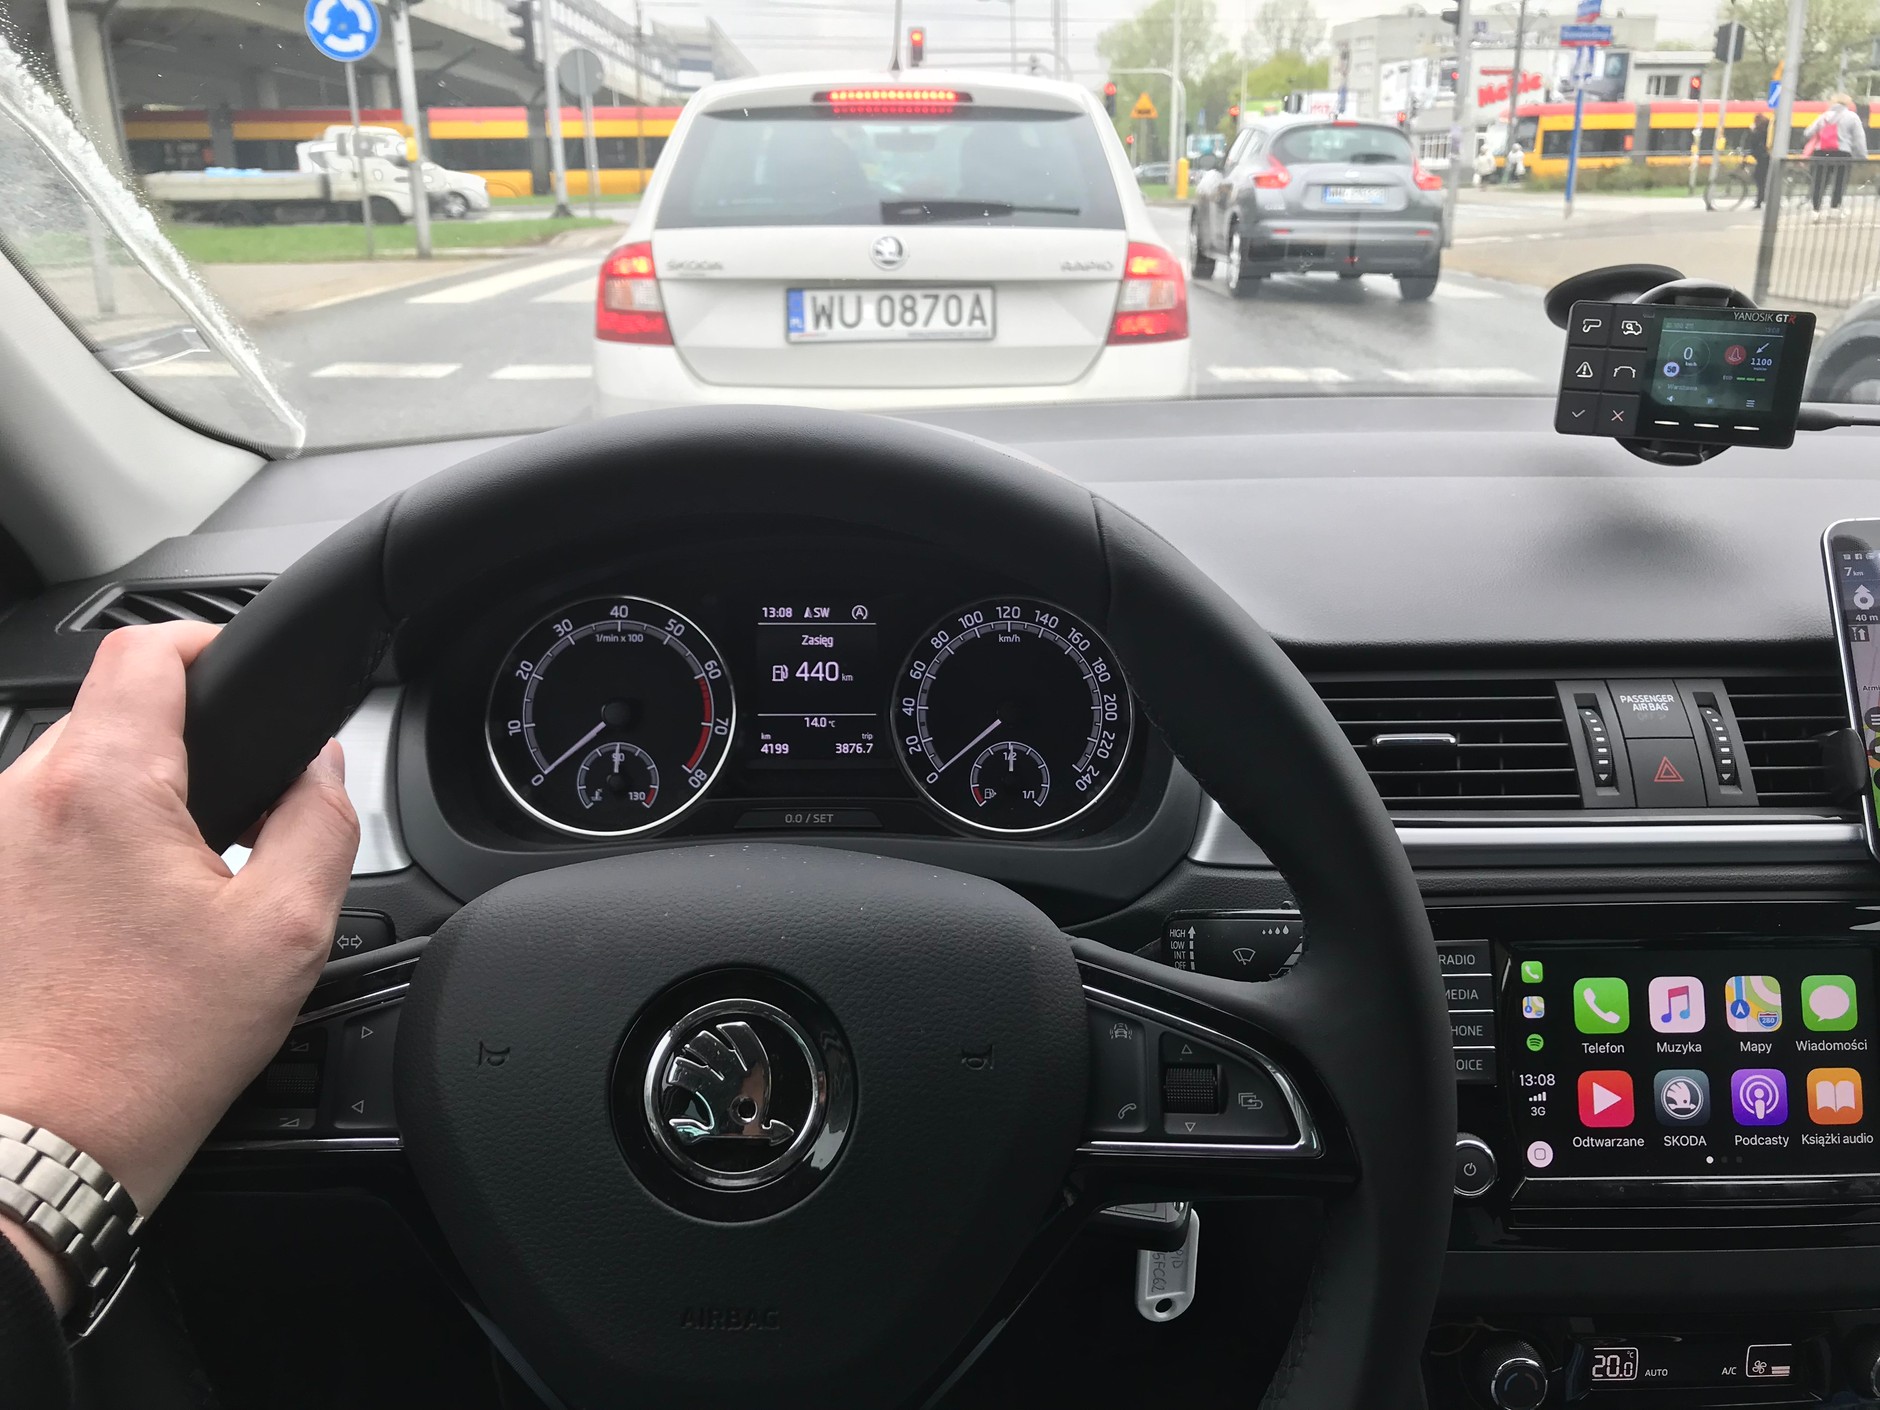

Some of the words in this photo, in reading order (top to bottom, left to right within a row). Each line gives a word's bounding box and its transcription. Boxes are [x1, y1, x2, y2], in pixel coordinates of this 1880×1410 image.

[810, 295, 863, 330] WU
[875, 293, 988, 328] 0870A
[1733, 311, 1774, 322] YANOSIK
[1775, 313, 1797, 324] GTR
[1683, 346, 1694, 360] 0
[1750, 357, 1773, 366] 1100
[1843, 566, 1853, 577] 7
[610, 605, 628, 618] 40
[762, 607, 793, 618] 13:08
[813, 607, 830, 618] SW
[996, 606, 1021, 619] 120
[958, 610, 984, 629] 100
[1034, 610, 1059, 629] 140
[552, 618, 574, 637] 30
[664, 618, 685, 637] 50
[596, 634, 619, 643] 1/min
[620, 635, 627, 643] x
[628, 634, 644, 643] 100
[801, 635, 834, 648] Zasięg
[930, 630, 950, 649] 80
[998, 634, 1021, 643] km/h
[1067, 627, 1091, 651] 160
[515, 660, 534, 681] 20
[703, 659, 722, 680] 60
[795, 661, 840, 682] 440
[841, 673, 853, 682] km
[909, 660, 926, 680] 60
[1091, 657, 1111, 683] 180
[1619, 694, 1675, 703] PASSENGER
[902, 697, 915, 716] 40
[1103, 694, 1118, 721] 200
[507, 719, 522, 736] 10
[714, 718, 729, 736] 70
[804, 717, 827, 728] 14.0
[760, 732, 771, 740] km
[861, 732, 874, 741] trip
[760, 743, 789, 754] 4199
[835, 743, 874, 754] 3876.7
[905, 735, 922, 754] 20
[1096, 730, 1115, 759] 220
[531, 773, 545, 787] 0
[688, 769, 708, 789] 80
[926, 772, 939, 784] 0
[1075, 765, 1100, 791] 240
[629, 792, 646, 801] 130
[1022, 790, 1035, 799] 1/1
[785, 814, 803, 823] 0.0
[813, 814, 834, 823] SET
[1170, 929, 1186, 938] HIGH
[1170, 940, 1185, 949] LOW
[1173, 951, 1186, 960] INT
[1438, 954, 1476, 965] RADIO
[1174, 961, 1186, 970] OFF
[1762, 1017, 1775, 1025] 280
[1450, 1025, 1483, 1036] HONE
[1581, 1042, 1625, 1054] Telefon
[1656, 1042, 1702, 1056] Muzyka
[1739, 1040, 1772, 1055] Mapy
[1795, 1039, 1868, 1052] Wiadomości
[1456, 1059, 1483, 1070] OICE
[1519, 1074, 1556, 1087] 13:08
[1530, 1106, 1546, 1117] 3G
[1572, 1135, 1645, 1148] Odtwarzane
[1663, 1135, 1707, 1147] SKODA
[1734, 1133, 1790, 1148] Podcasty
[1801, 1133, 1840, 1147] Książki
[1841, 1132, 1874, 1144] audio
[680, 1307, 781, 1331] AIRBAG
[1644, 1368, 1669, 1377] AUTO
[1721, 1366, 1737, 1376] A/C
